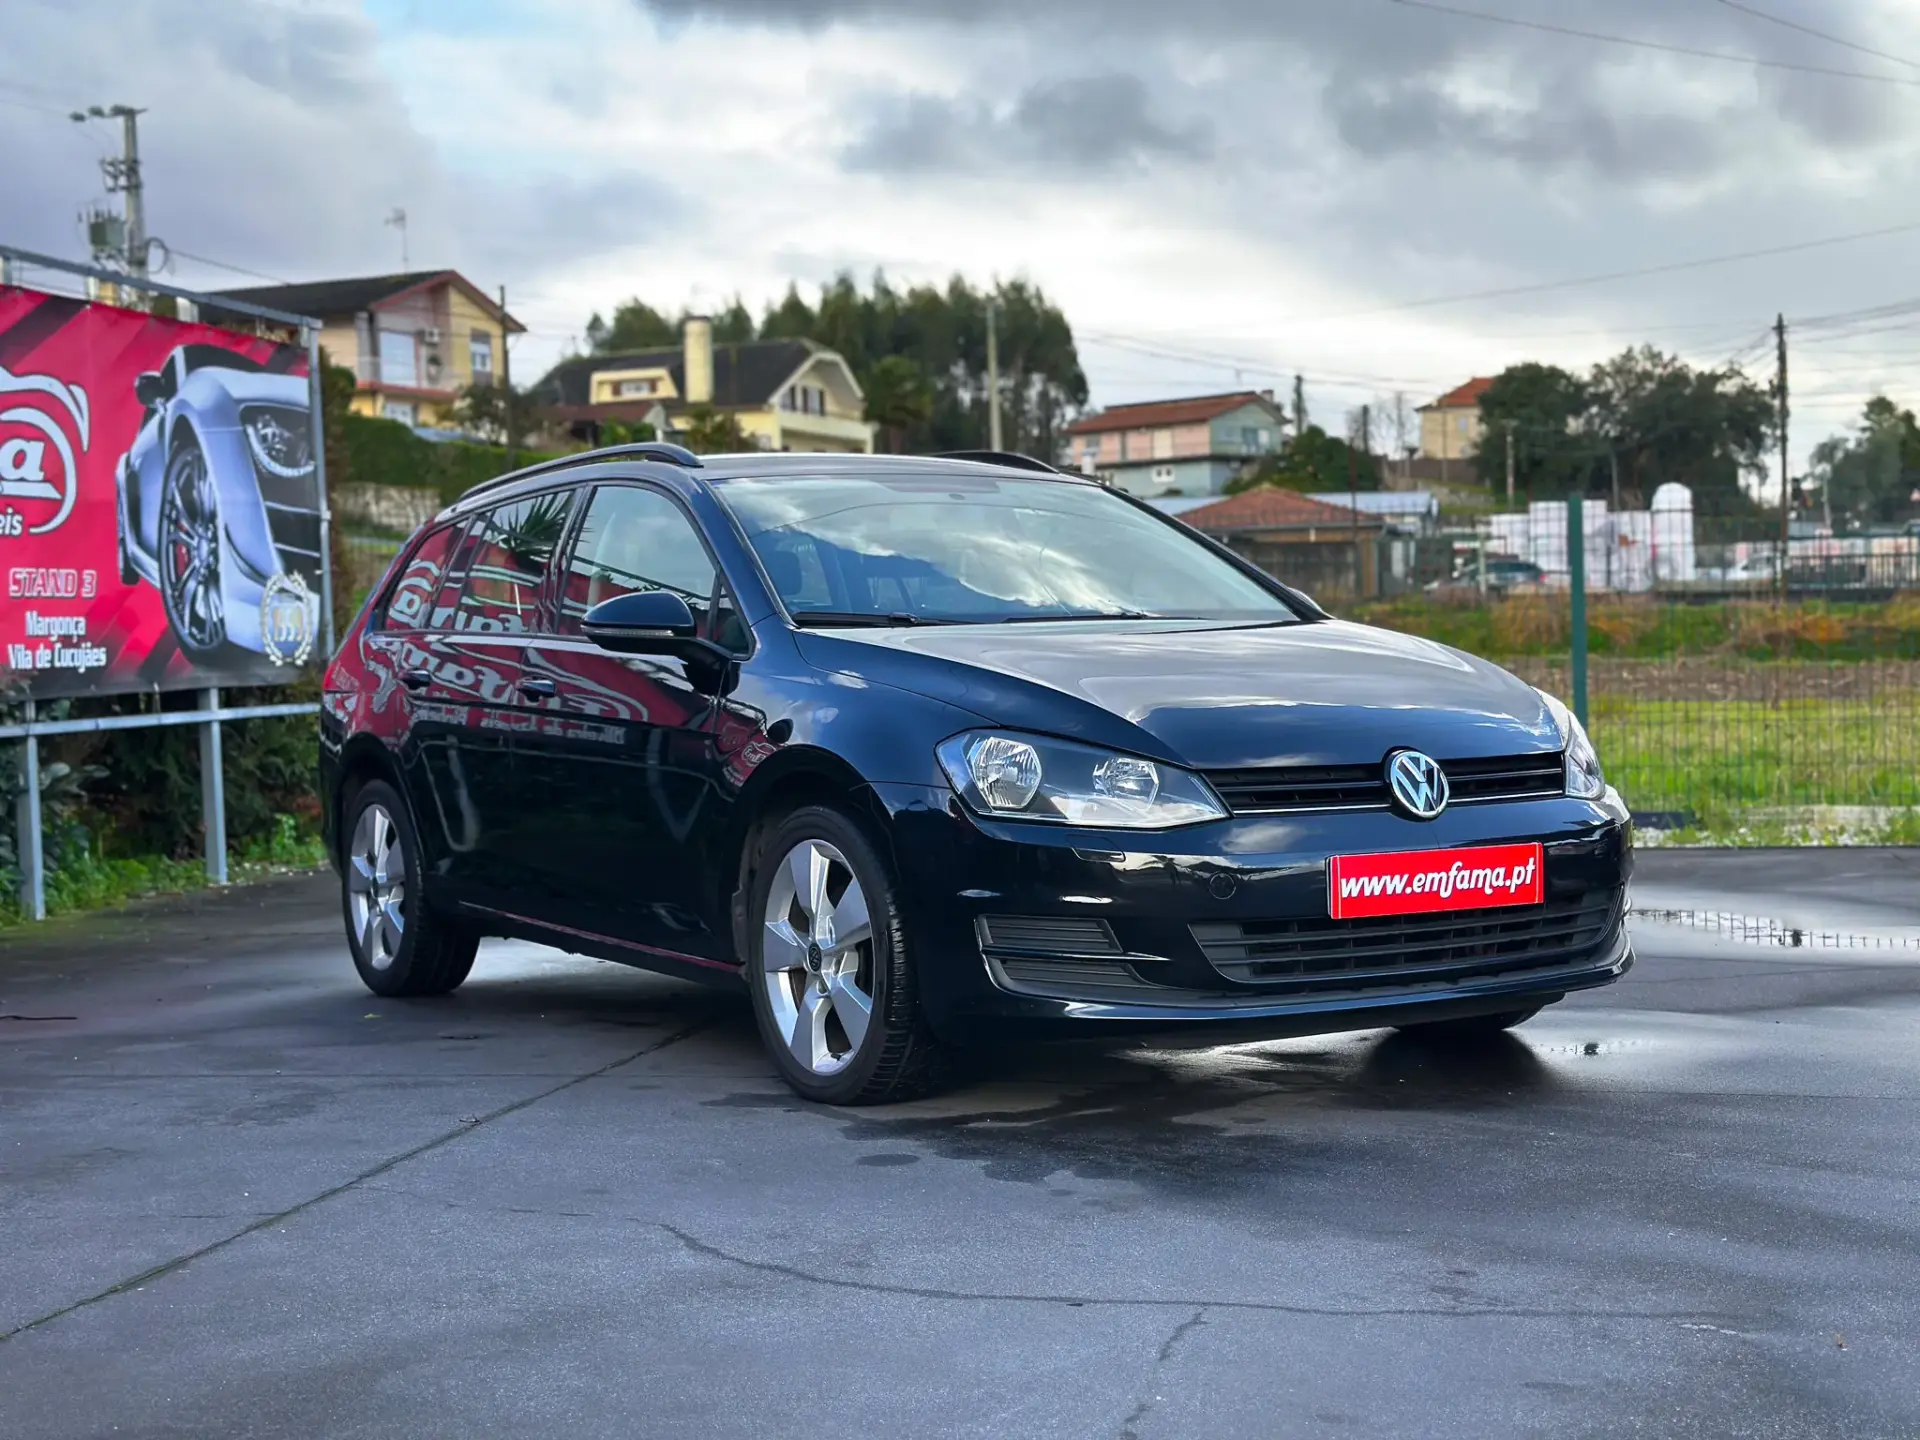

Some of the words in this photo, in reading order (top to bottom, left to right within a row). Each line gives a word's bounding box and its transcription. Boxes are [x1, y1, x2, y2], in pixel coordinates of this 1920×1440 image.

[9, 567, 78, 598] STAND
[81, 569, 97, 597] 3
[8, 643, 33, 669] Vila
[35, 643, 52, 669] de
[1391, 752, 1448, 816] VW
[1341, 858, 1535, 898] www.emfama.pt
